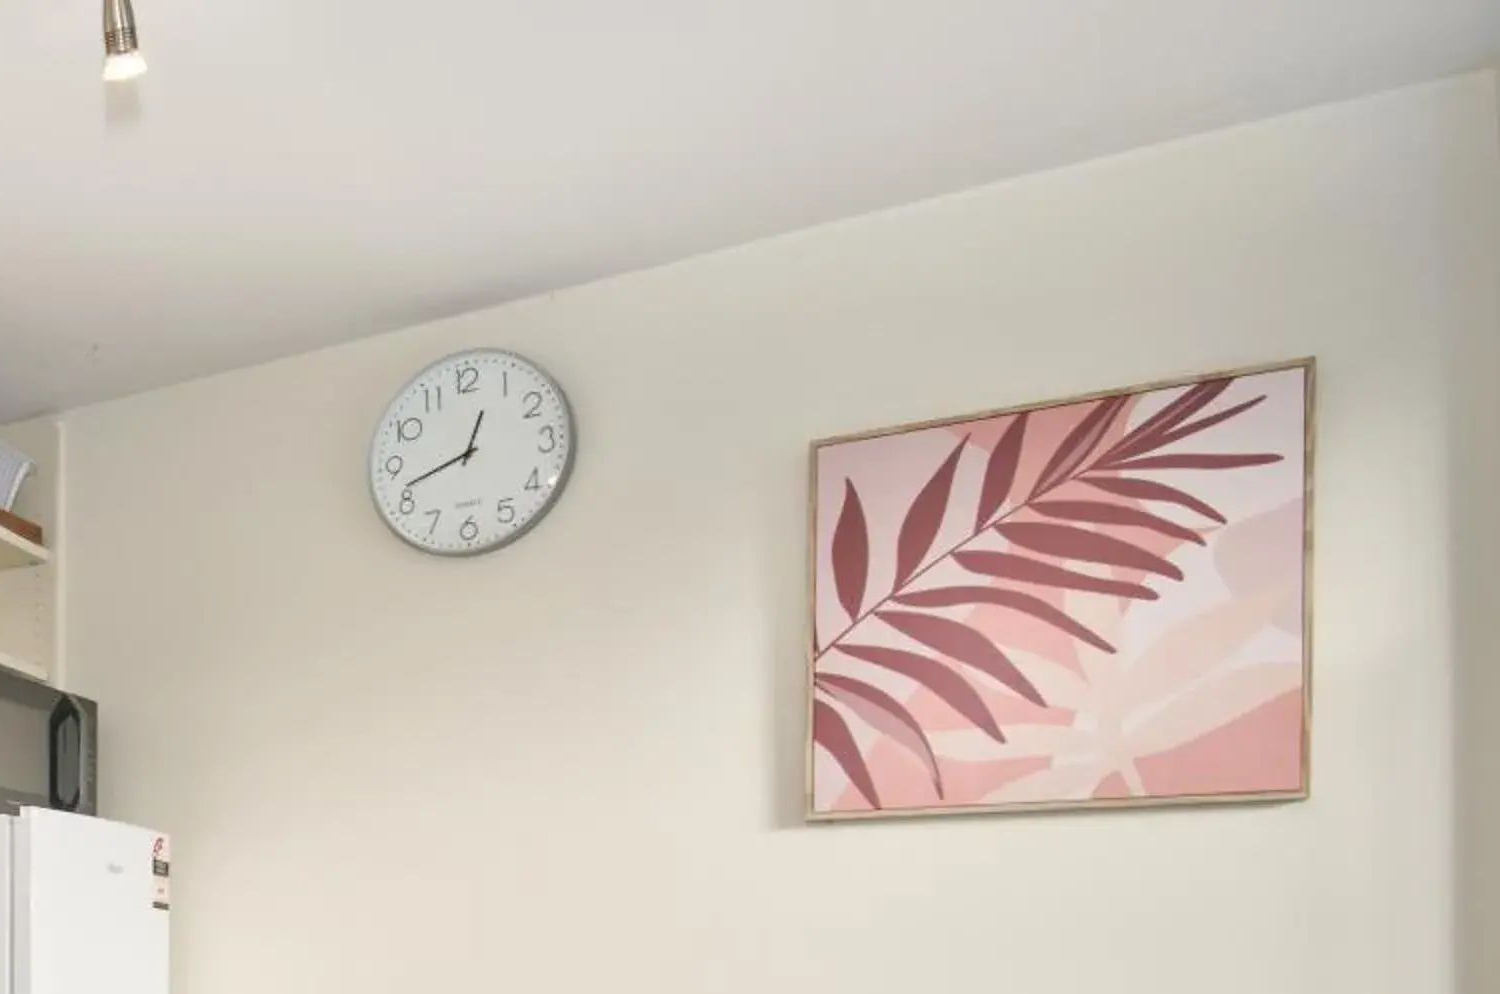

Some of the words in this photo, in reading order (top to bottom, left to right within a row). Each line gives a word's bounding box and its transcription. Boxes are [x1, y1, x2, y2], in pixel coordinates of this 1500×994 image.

[456, 367, 479, 394] 12
[503, 371, 508, 397] 1
[424, 386, 442, 413] 11
[522, 391, 543, 419] 2
[397, 417, 423, 443] 10
[538, 425, 555, 454] 3
[385, 456, 403, 480] 9
[524, 466, 541, 491] 4
[399, 488, 415, 515] 8
[497, 498, 515, 524] 5
[424, 509, 441, 535] 7
[459, 515, 478, 541] 6
